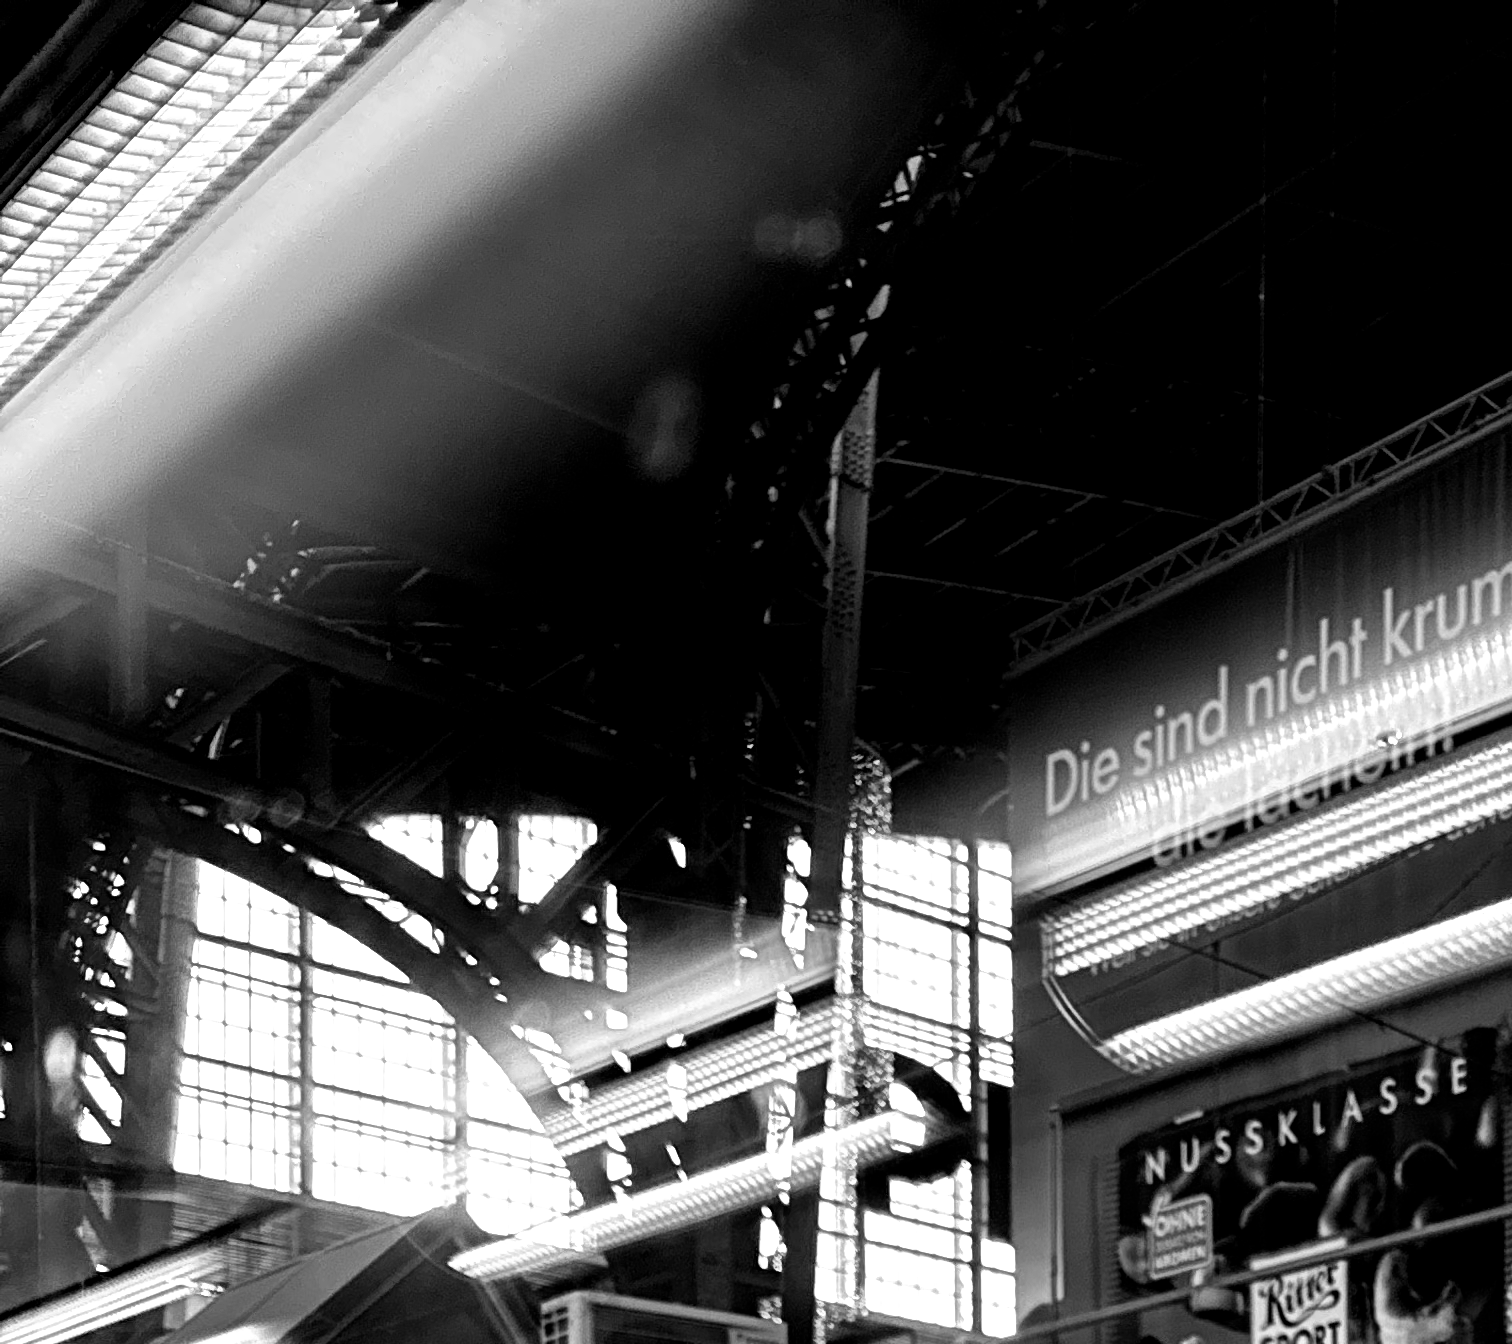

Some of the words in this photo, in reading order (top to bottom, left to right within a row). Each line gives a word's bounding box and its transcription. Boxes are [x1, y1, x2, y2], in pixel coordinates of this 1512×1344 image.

[1045, 742, 1120, 818] Die
[1133, 666, 1229, 776] sind
[1246, 617, 1368, 726] nicht
